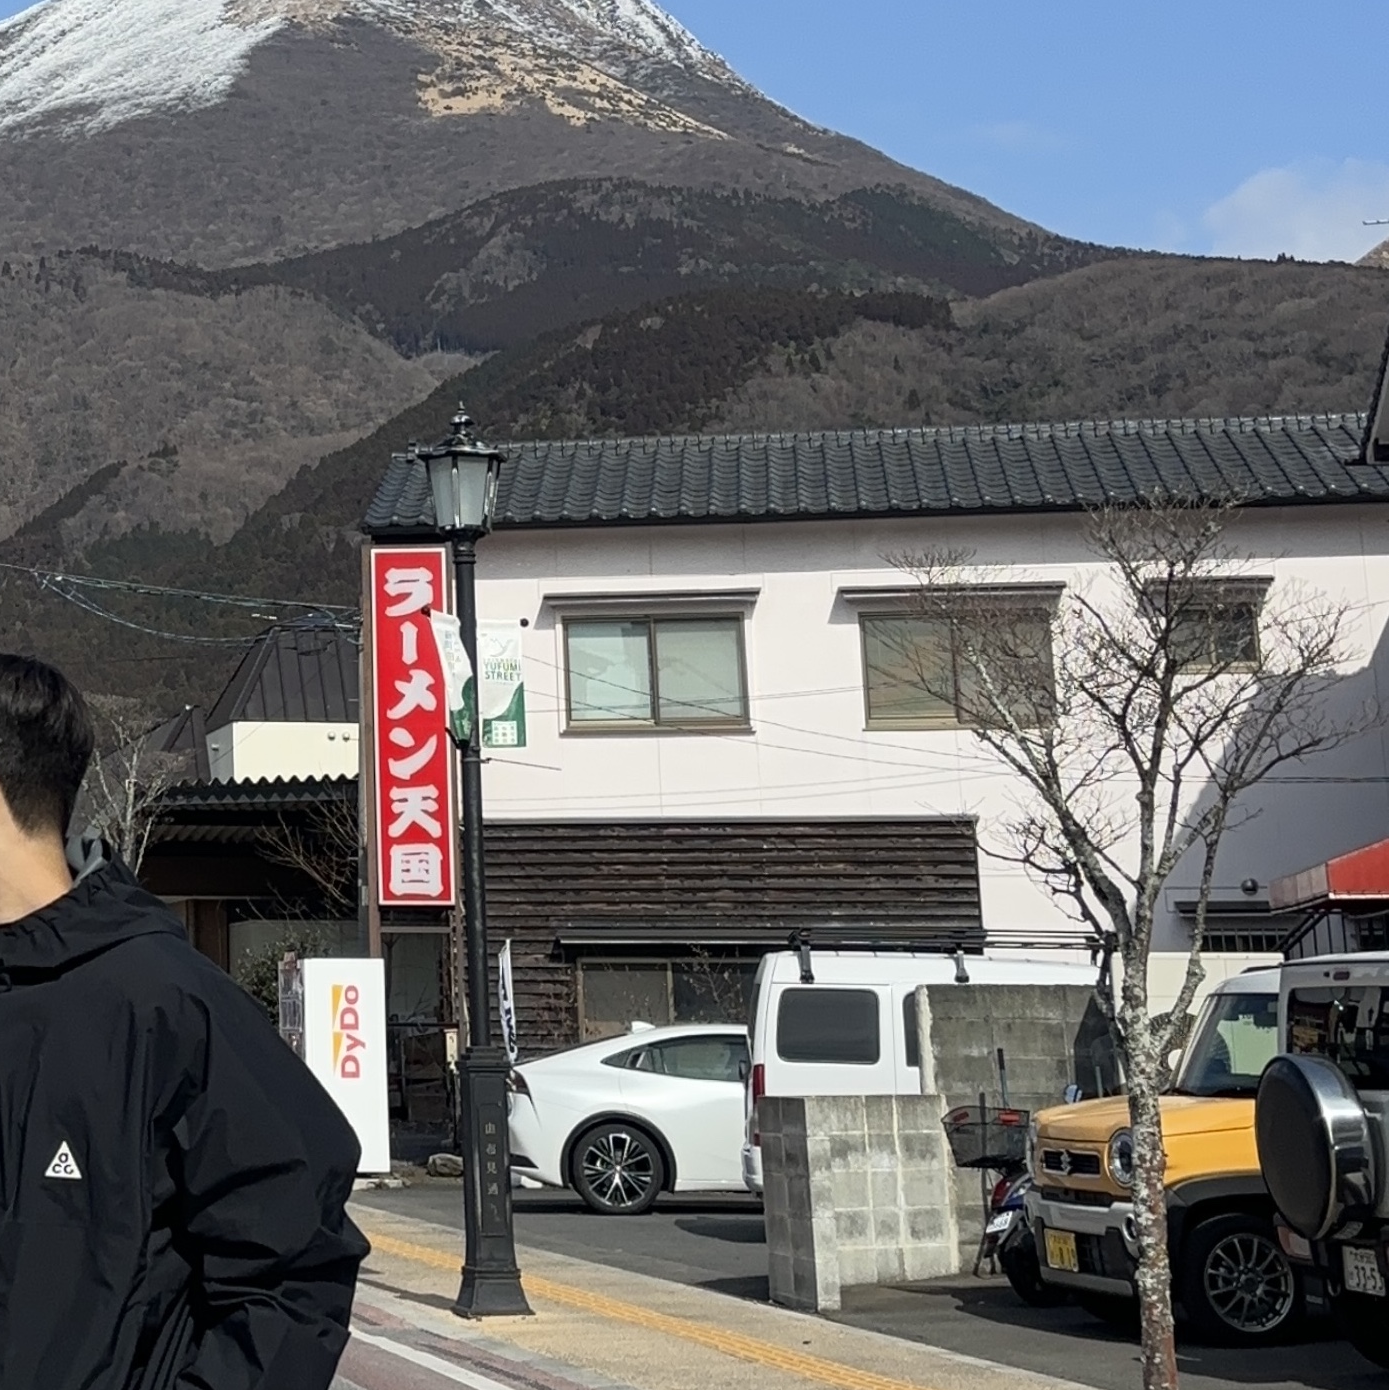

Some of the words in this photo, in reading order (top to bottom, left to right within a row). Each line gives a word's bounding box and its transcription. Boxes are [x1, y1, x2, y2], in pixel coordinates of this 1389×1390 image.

[483, 662, 521, 671] YUFUMI
[485, 671, 522, 681] STREET
[383, 566, 444, 897] ラーメン天国
[340, 984, 366, 1078] DyDo
